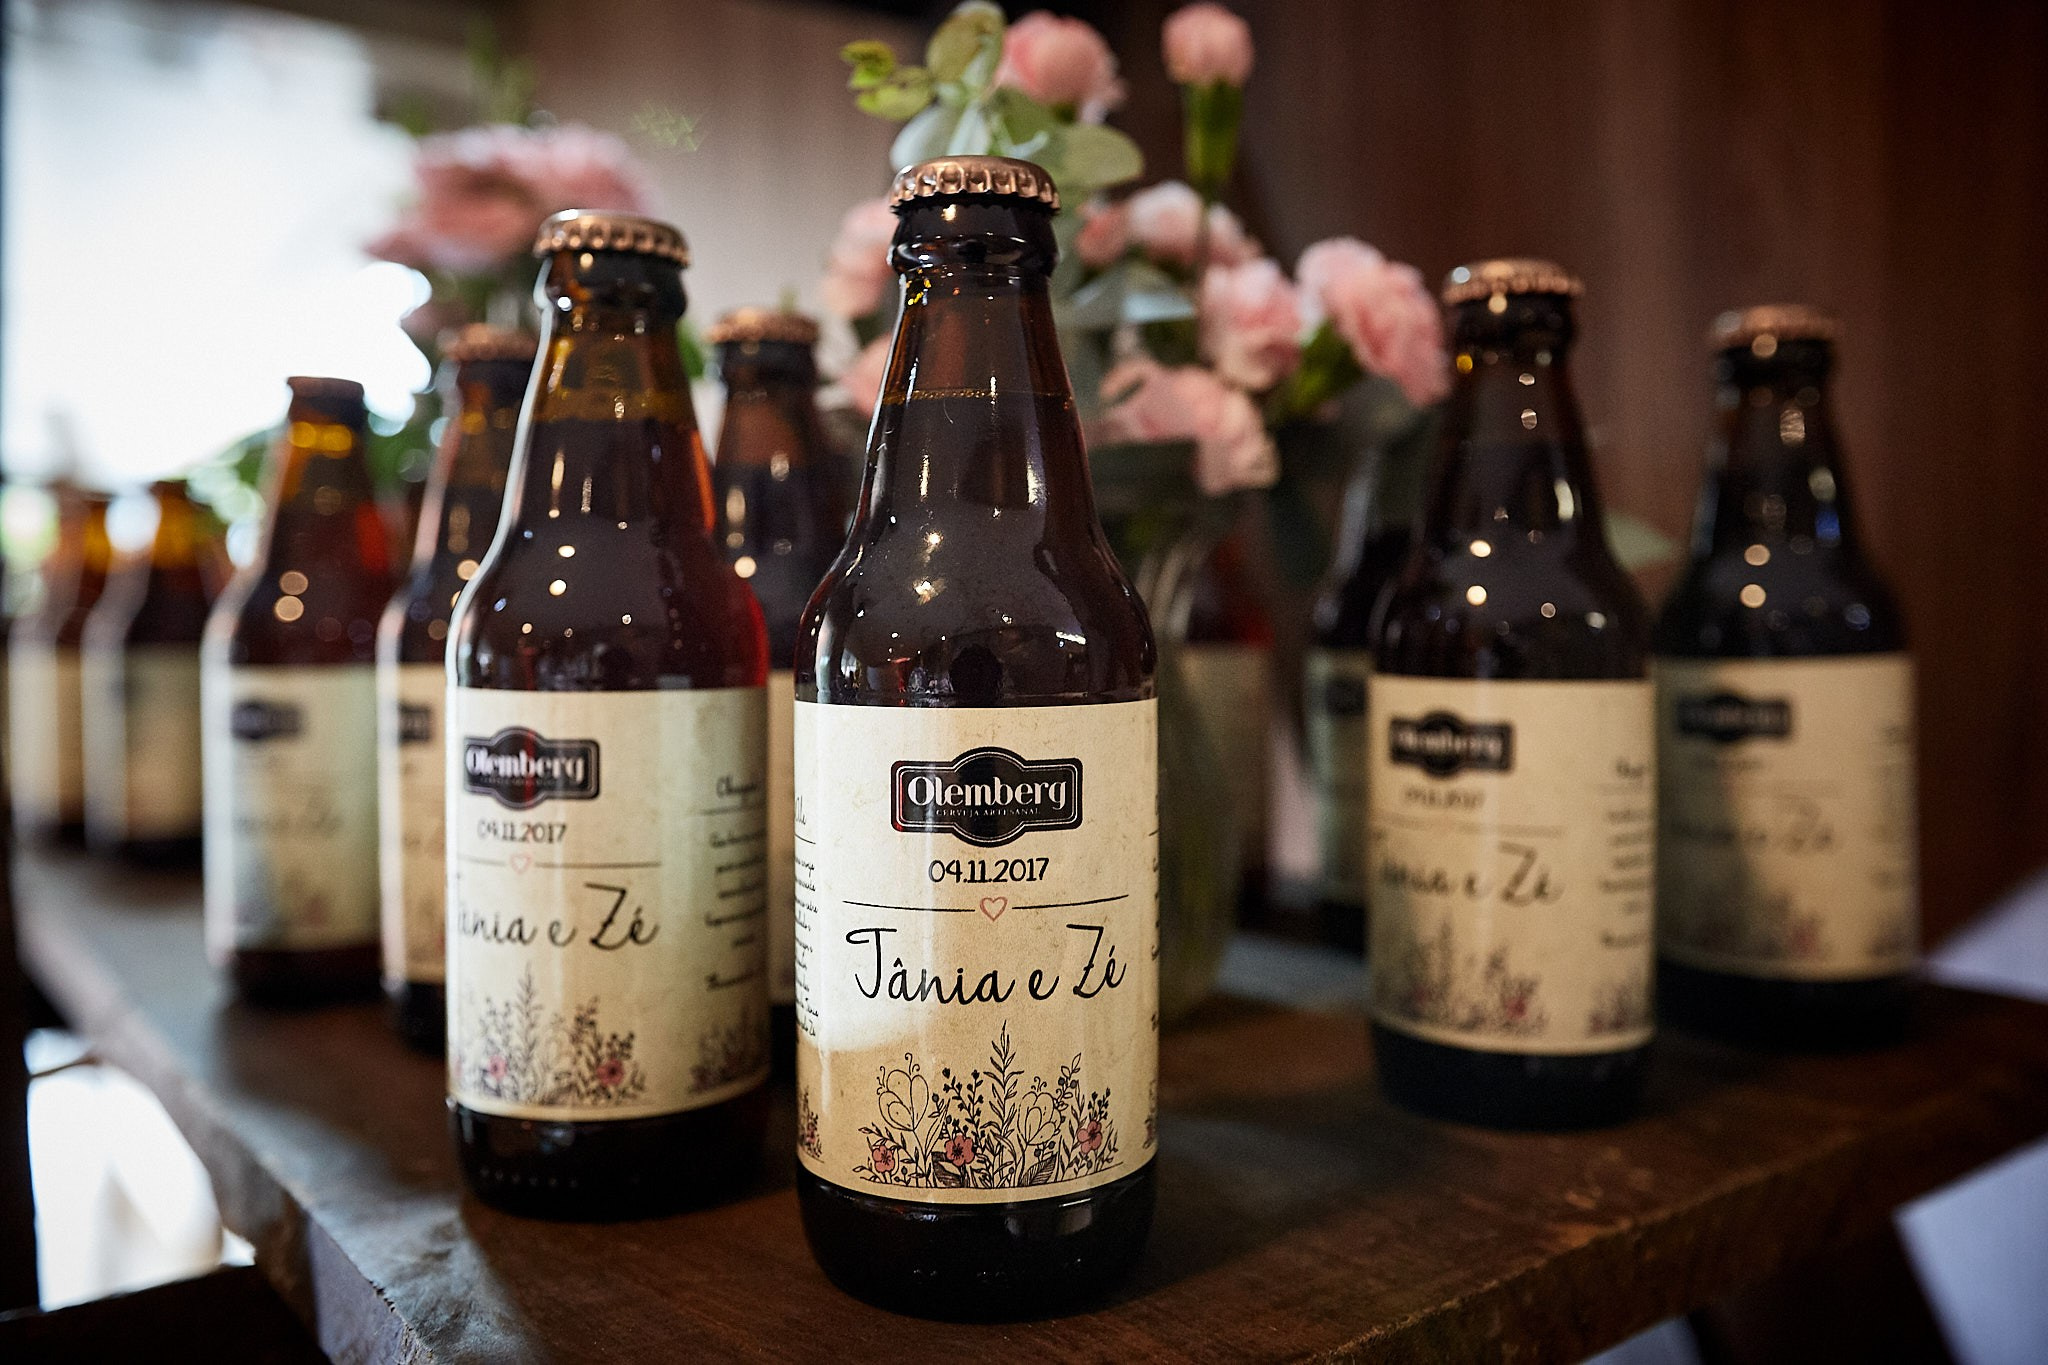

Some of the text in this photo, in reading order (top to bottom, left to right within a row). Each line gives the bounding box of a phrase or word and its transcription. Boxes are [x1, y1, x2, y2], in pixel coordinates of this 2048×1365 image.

[466, 746, 586, 783] Olemberg
[907, 775, 1068, 811] Olemberg
[928, 857, 1050, 884] 04.11.2017
[457, 908, 538, 946] nia
[845, 926, 1016, 1006] Tânia
[1028, 969, 1060, 1001] e
[1066, 923, 1128, 999] Zé
